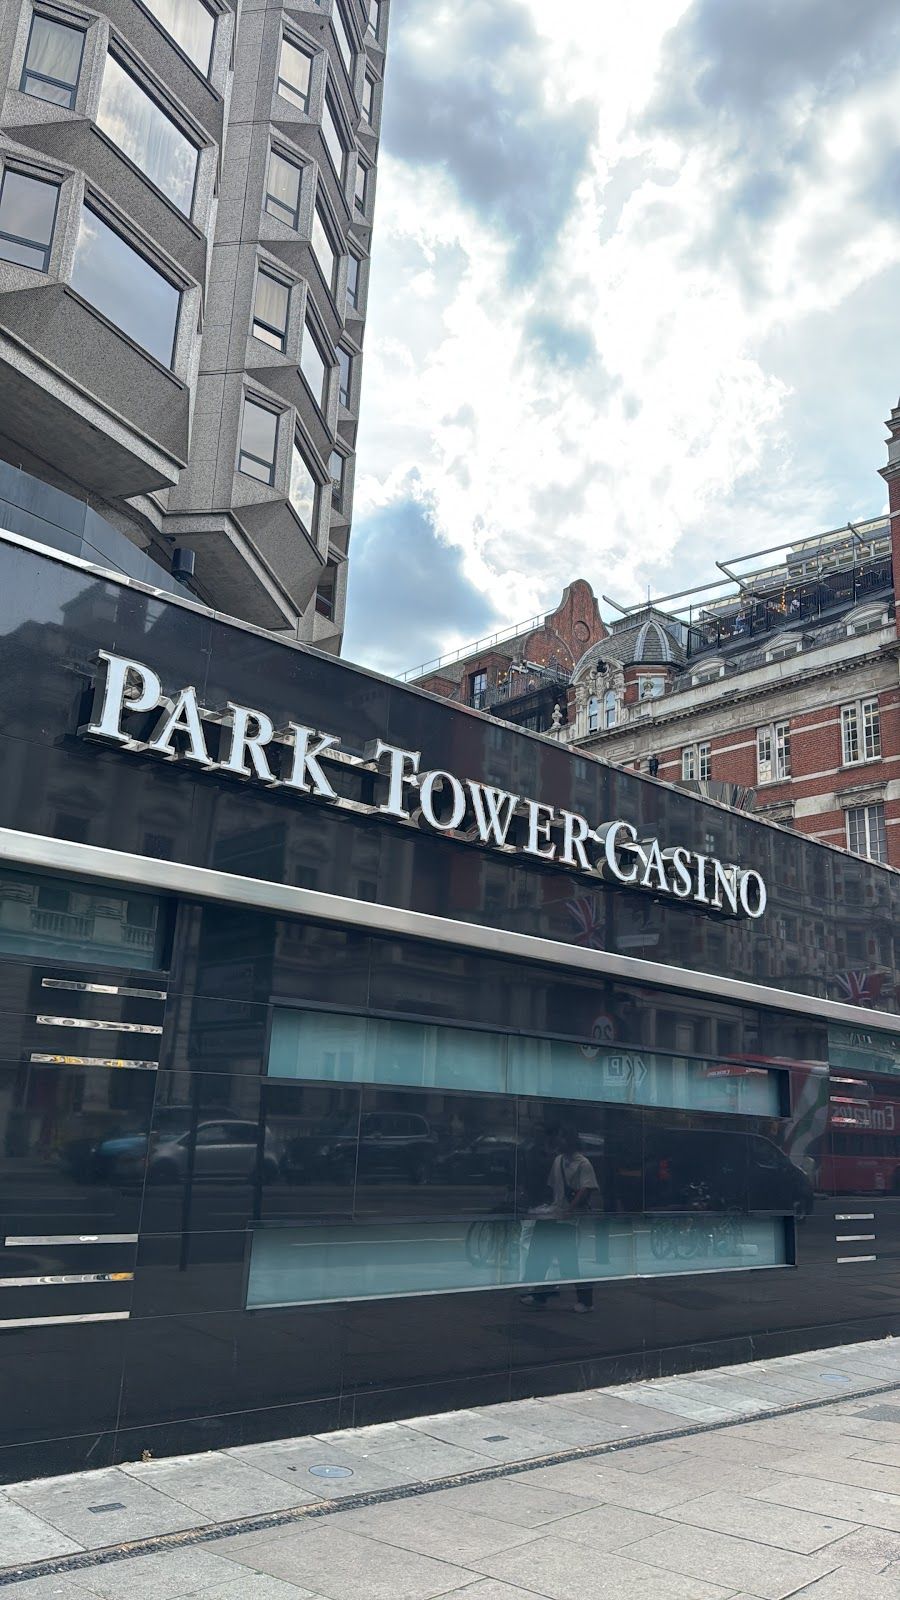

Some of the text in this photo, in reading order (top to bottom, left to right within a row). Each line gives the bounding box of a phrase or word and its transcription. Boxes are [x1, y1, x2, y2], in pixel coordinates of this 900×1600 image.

[88, 649, 767, 919] PARK TOWER CASINO
